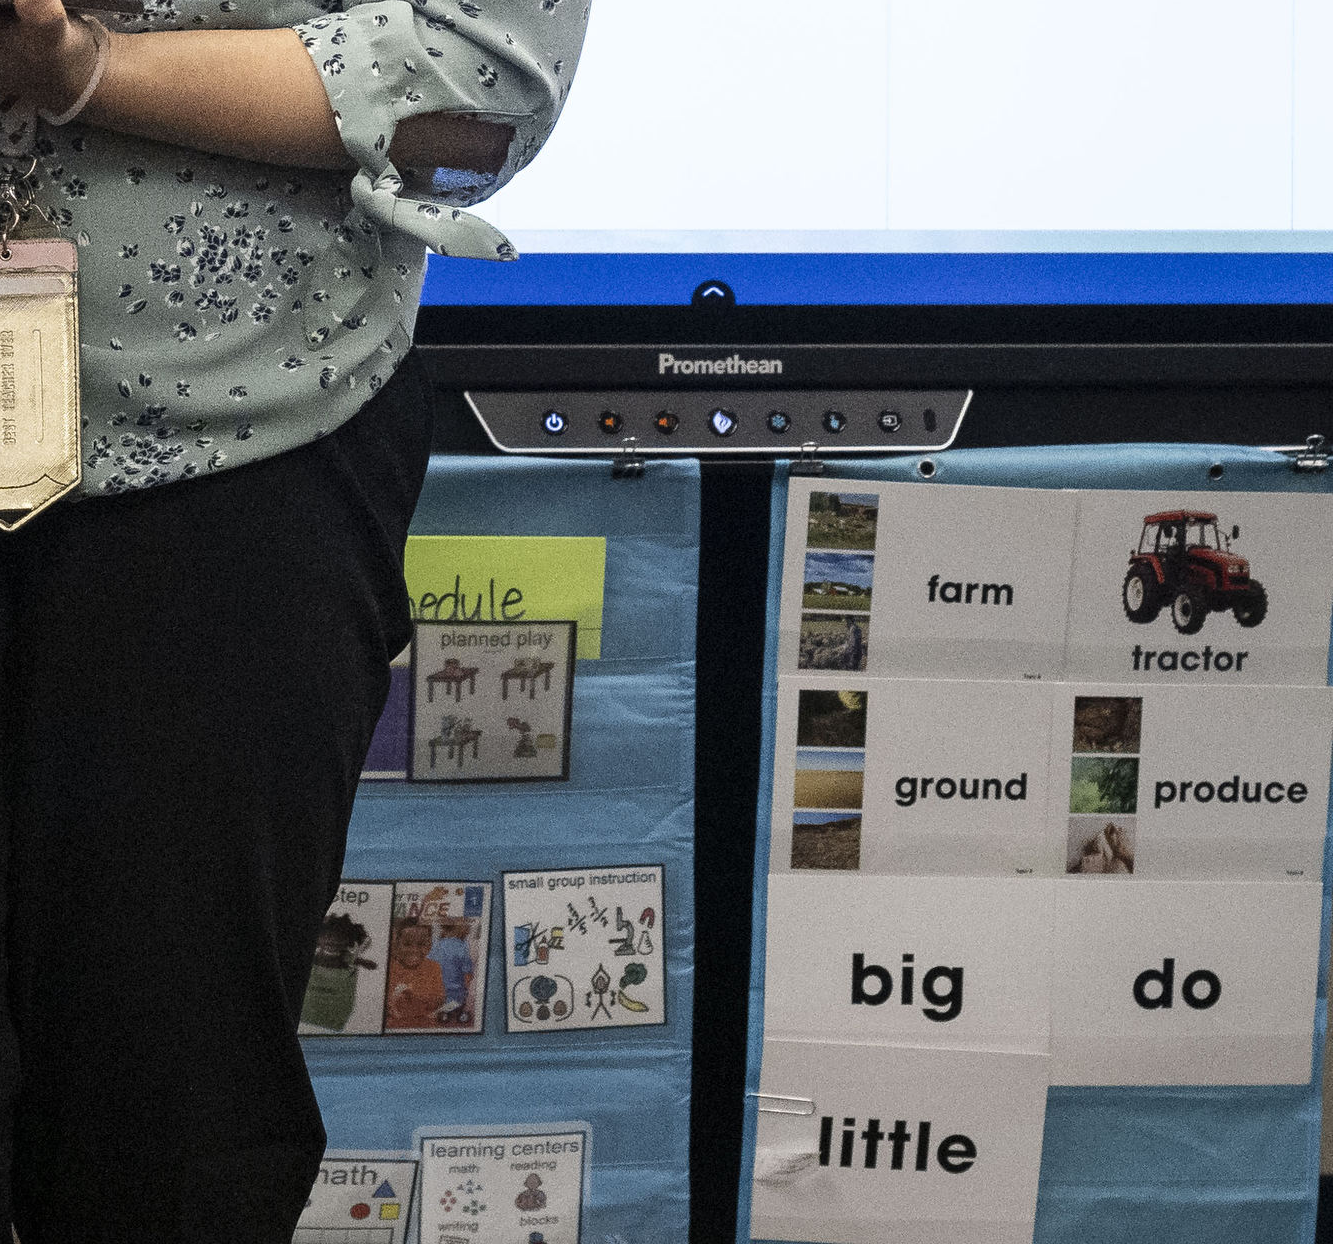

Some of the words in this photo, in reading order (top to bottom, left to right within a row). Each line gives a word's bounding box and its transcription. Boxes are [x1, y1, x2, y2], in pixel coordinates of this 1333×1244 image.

[658, 352, 783, 375] Promethean
[927, 574, 1014, 606] farm
[441, 630, 511, 651] planned
[517, 630, 553, 650] play
[1132, 644, 1249, 673] tractor
[895, 772, 1029, 808] ground
[1154, 774, 1309, 810] produce
[508, 872, 544, 891] small
[547, 874, 586, 892] group
[589, 870, 657, 888] instruction
[850, 952, 965, 1023] big
[1132, 957, 1223, 1011] do
[432, 1142, 505, 1161] learning
[512, 1140, 580, 1158] centers
[818, 1116, 978, 1174] little
[510, 1158, 558, 1173] reading
[437, 1220, 480, 1234] writing
